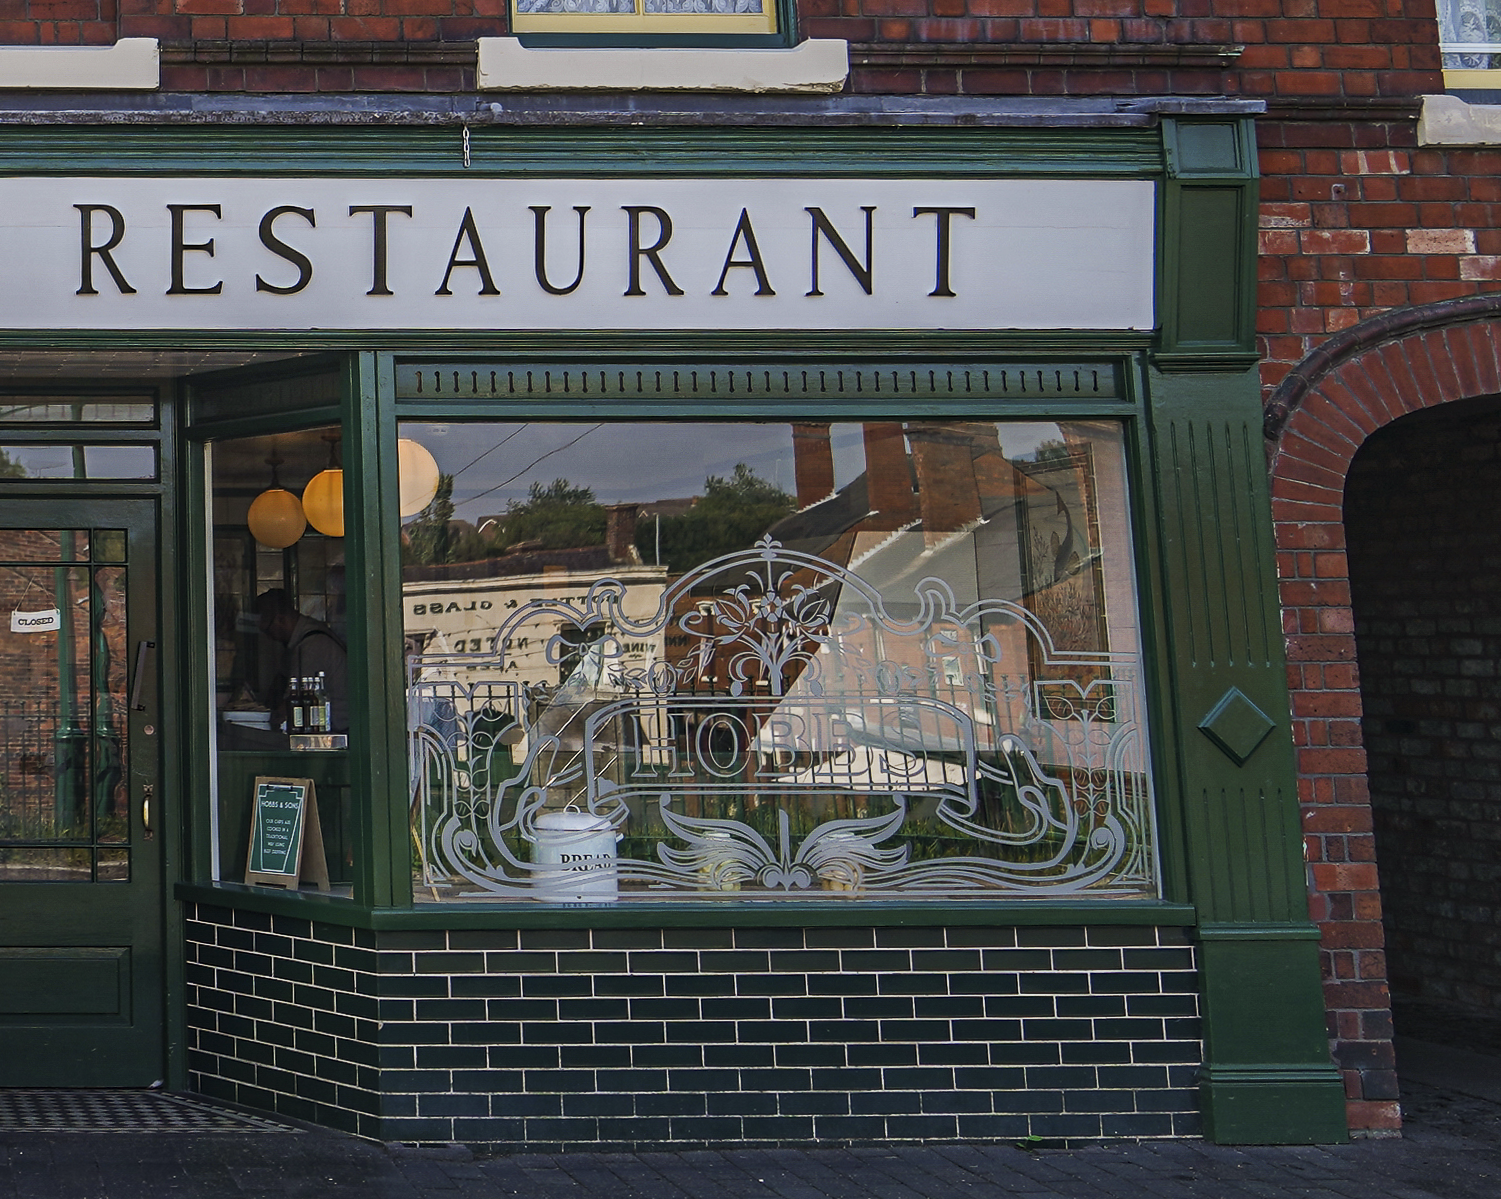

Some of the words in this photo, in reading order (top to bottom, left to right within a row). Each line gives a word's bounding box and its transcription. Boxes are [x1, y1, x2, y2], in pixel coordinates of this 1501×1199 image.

[73, 204, 975, 297] RESTAURANT
[18, 617, 54, 626] CLOSED
[630, 711, 927, 778] HOBBS
